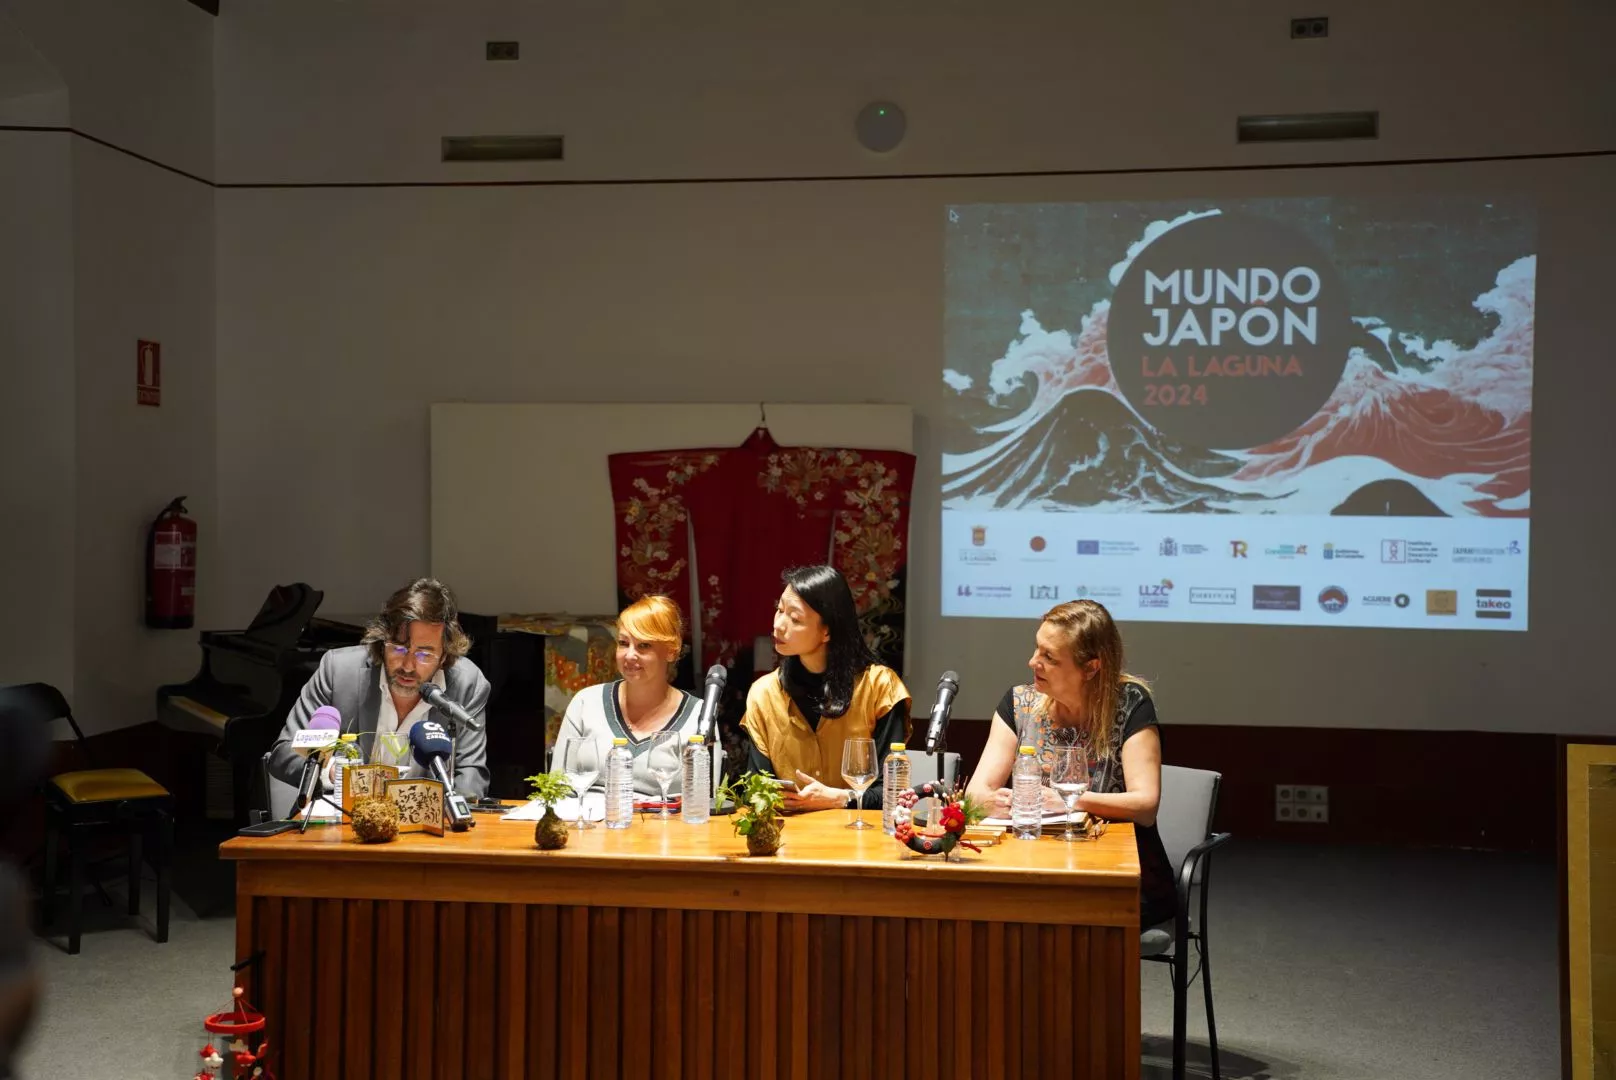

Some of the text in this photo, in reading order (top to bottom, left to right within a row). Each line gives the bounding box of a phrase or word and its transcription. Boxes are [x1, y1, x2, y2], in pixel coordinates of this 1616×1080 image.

[1144, 266, 1321, 305] MUNDO
[1141, 354, 1304, 377] LA LAGUNA
[1143, 384, 1208, 406] 2024
[1476, 598, 1511, 609] takeo
